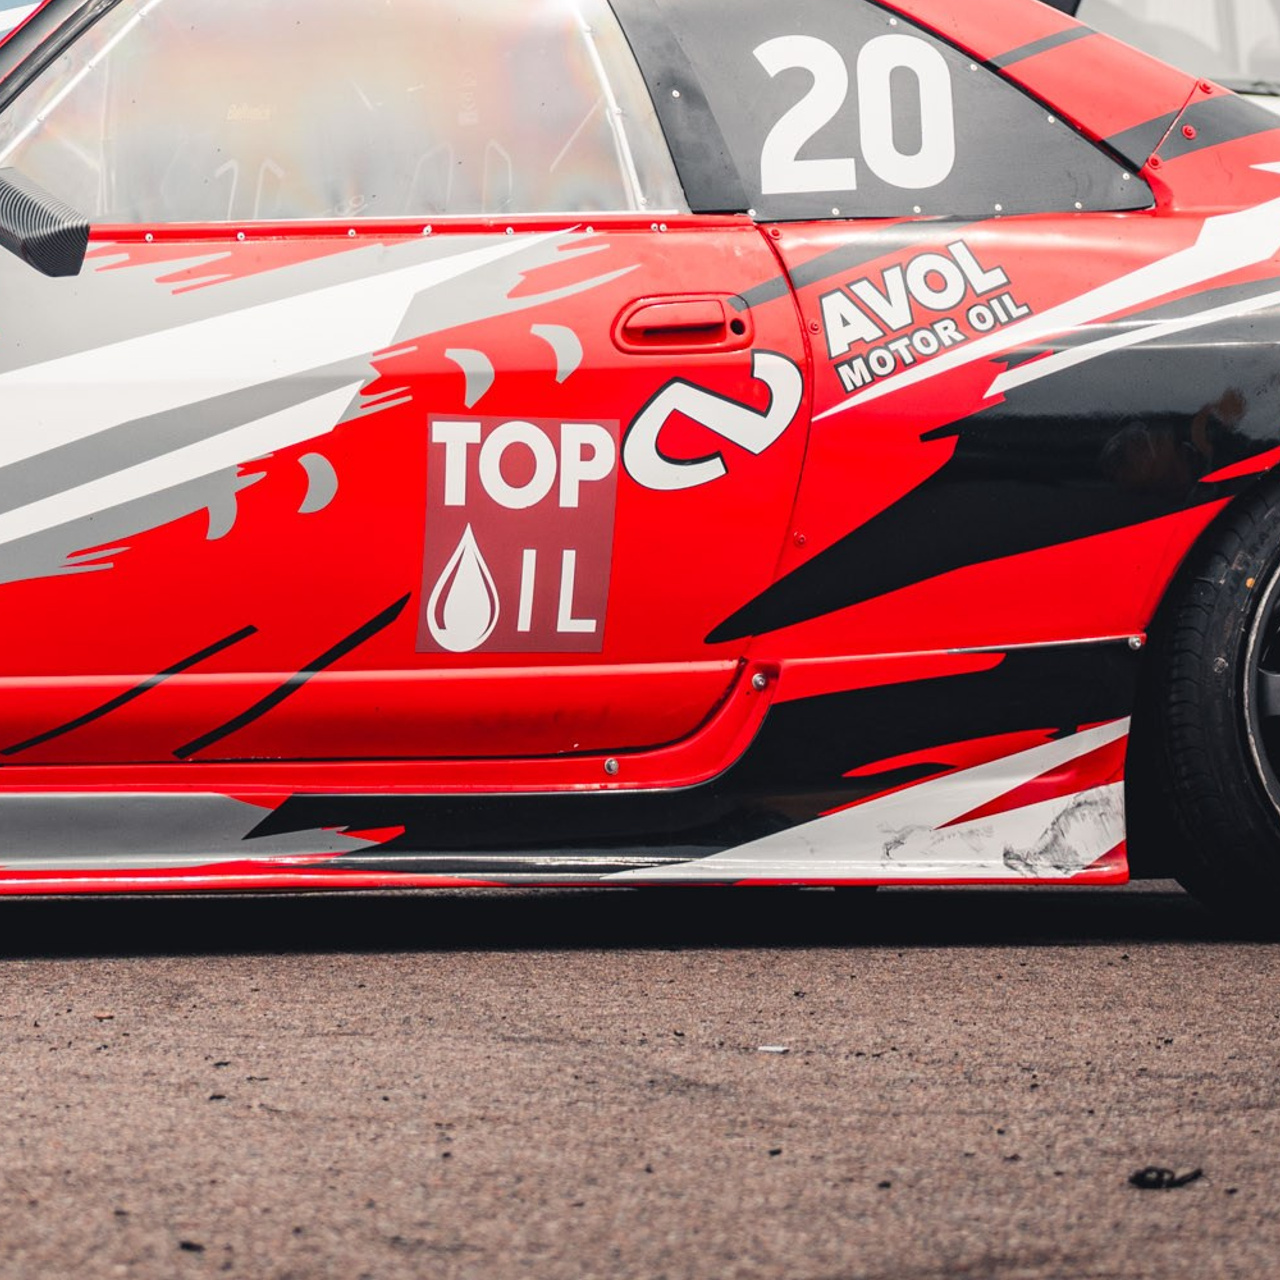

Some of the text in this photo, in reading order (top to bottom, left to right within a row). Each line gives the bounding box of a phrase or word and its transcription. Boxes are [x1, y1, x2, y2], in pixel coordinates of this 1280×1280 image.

[752, 33, 956, 196] 20
[819, 241, 1010, 360] AVOL
[835, 292, 1031, 394] MOTOR OIL
[431, 420, 616, 511] TOP
